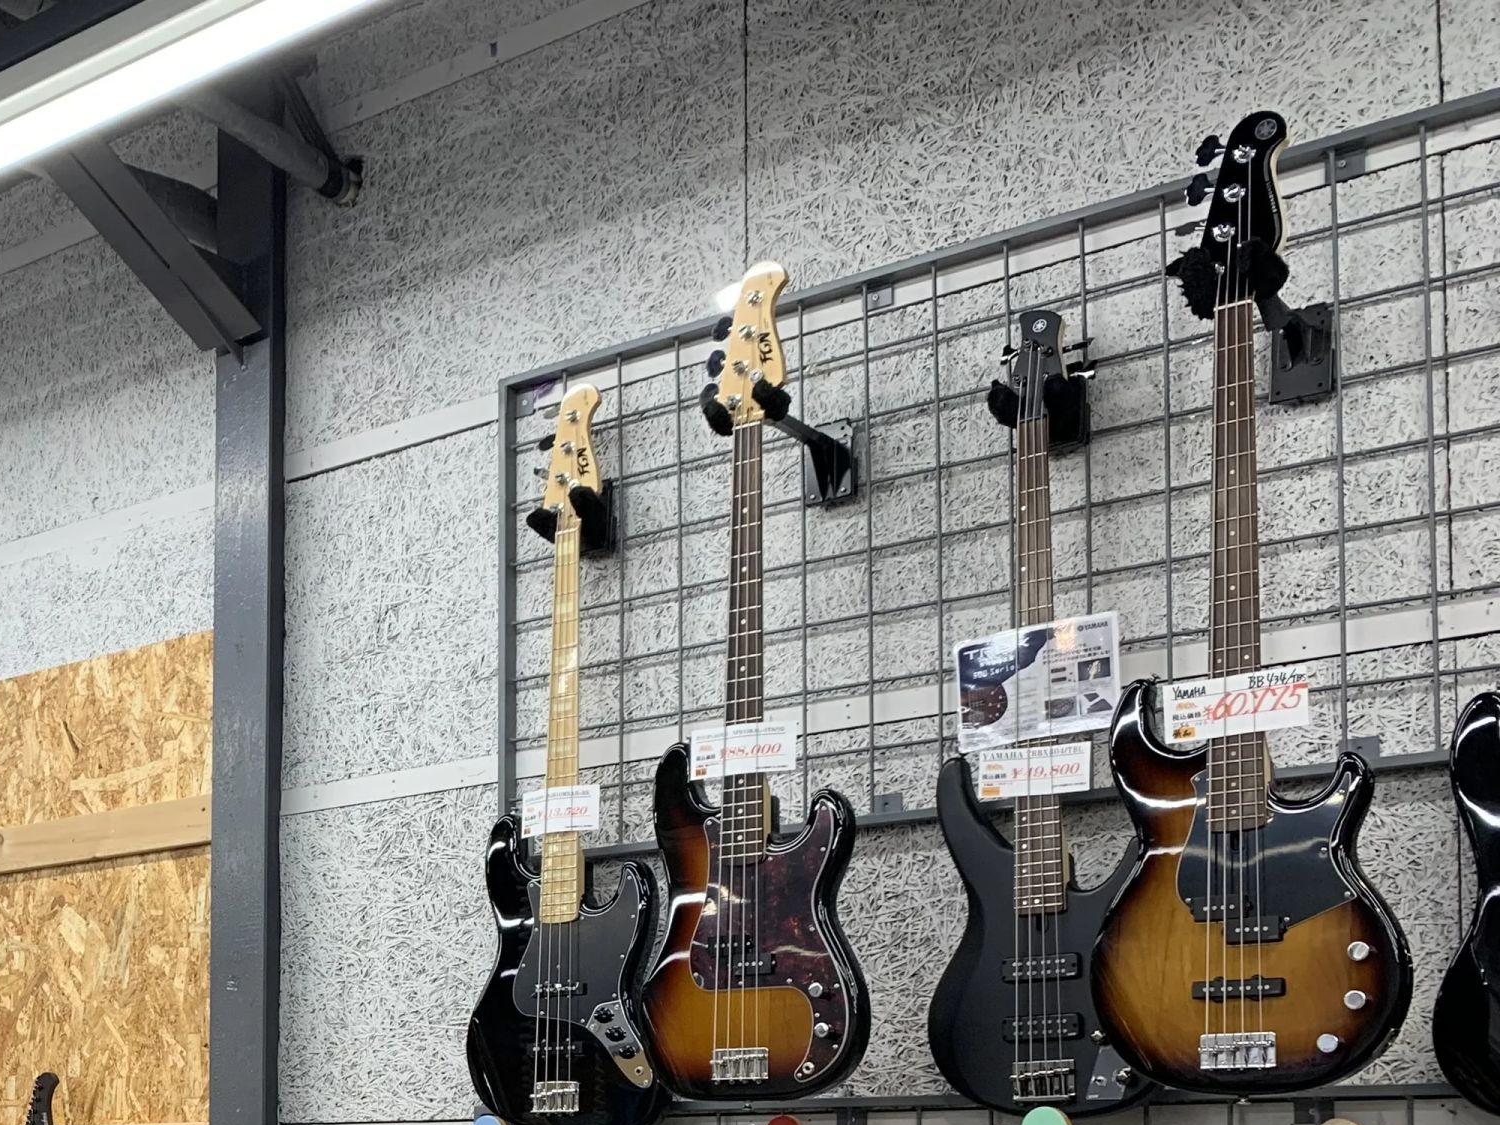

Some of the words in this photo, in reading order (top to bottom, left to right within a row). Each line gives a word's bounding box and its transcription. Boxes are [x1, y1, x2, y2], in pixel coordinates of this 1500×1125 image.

[757, 331, 773, 365] FGN
[577, 447, 590, 477] FGN
[1084, 621, 1109, 632] YAMAHA
[1172, 686, 1206, 701] YAMAHA
[983, 752, 1023, 761] YAMAHA
